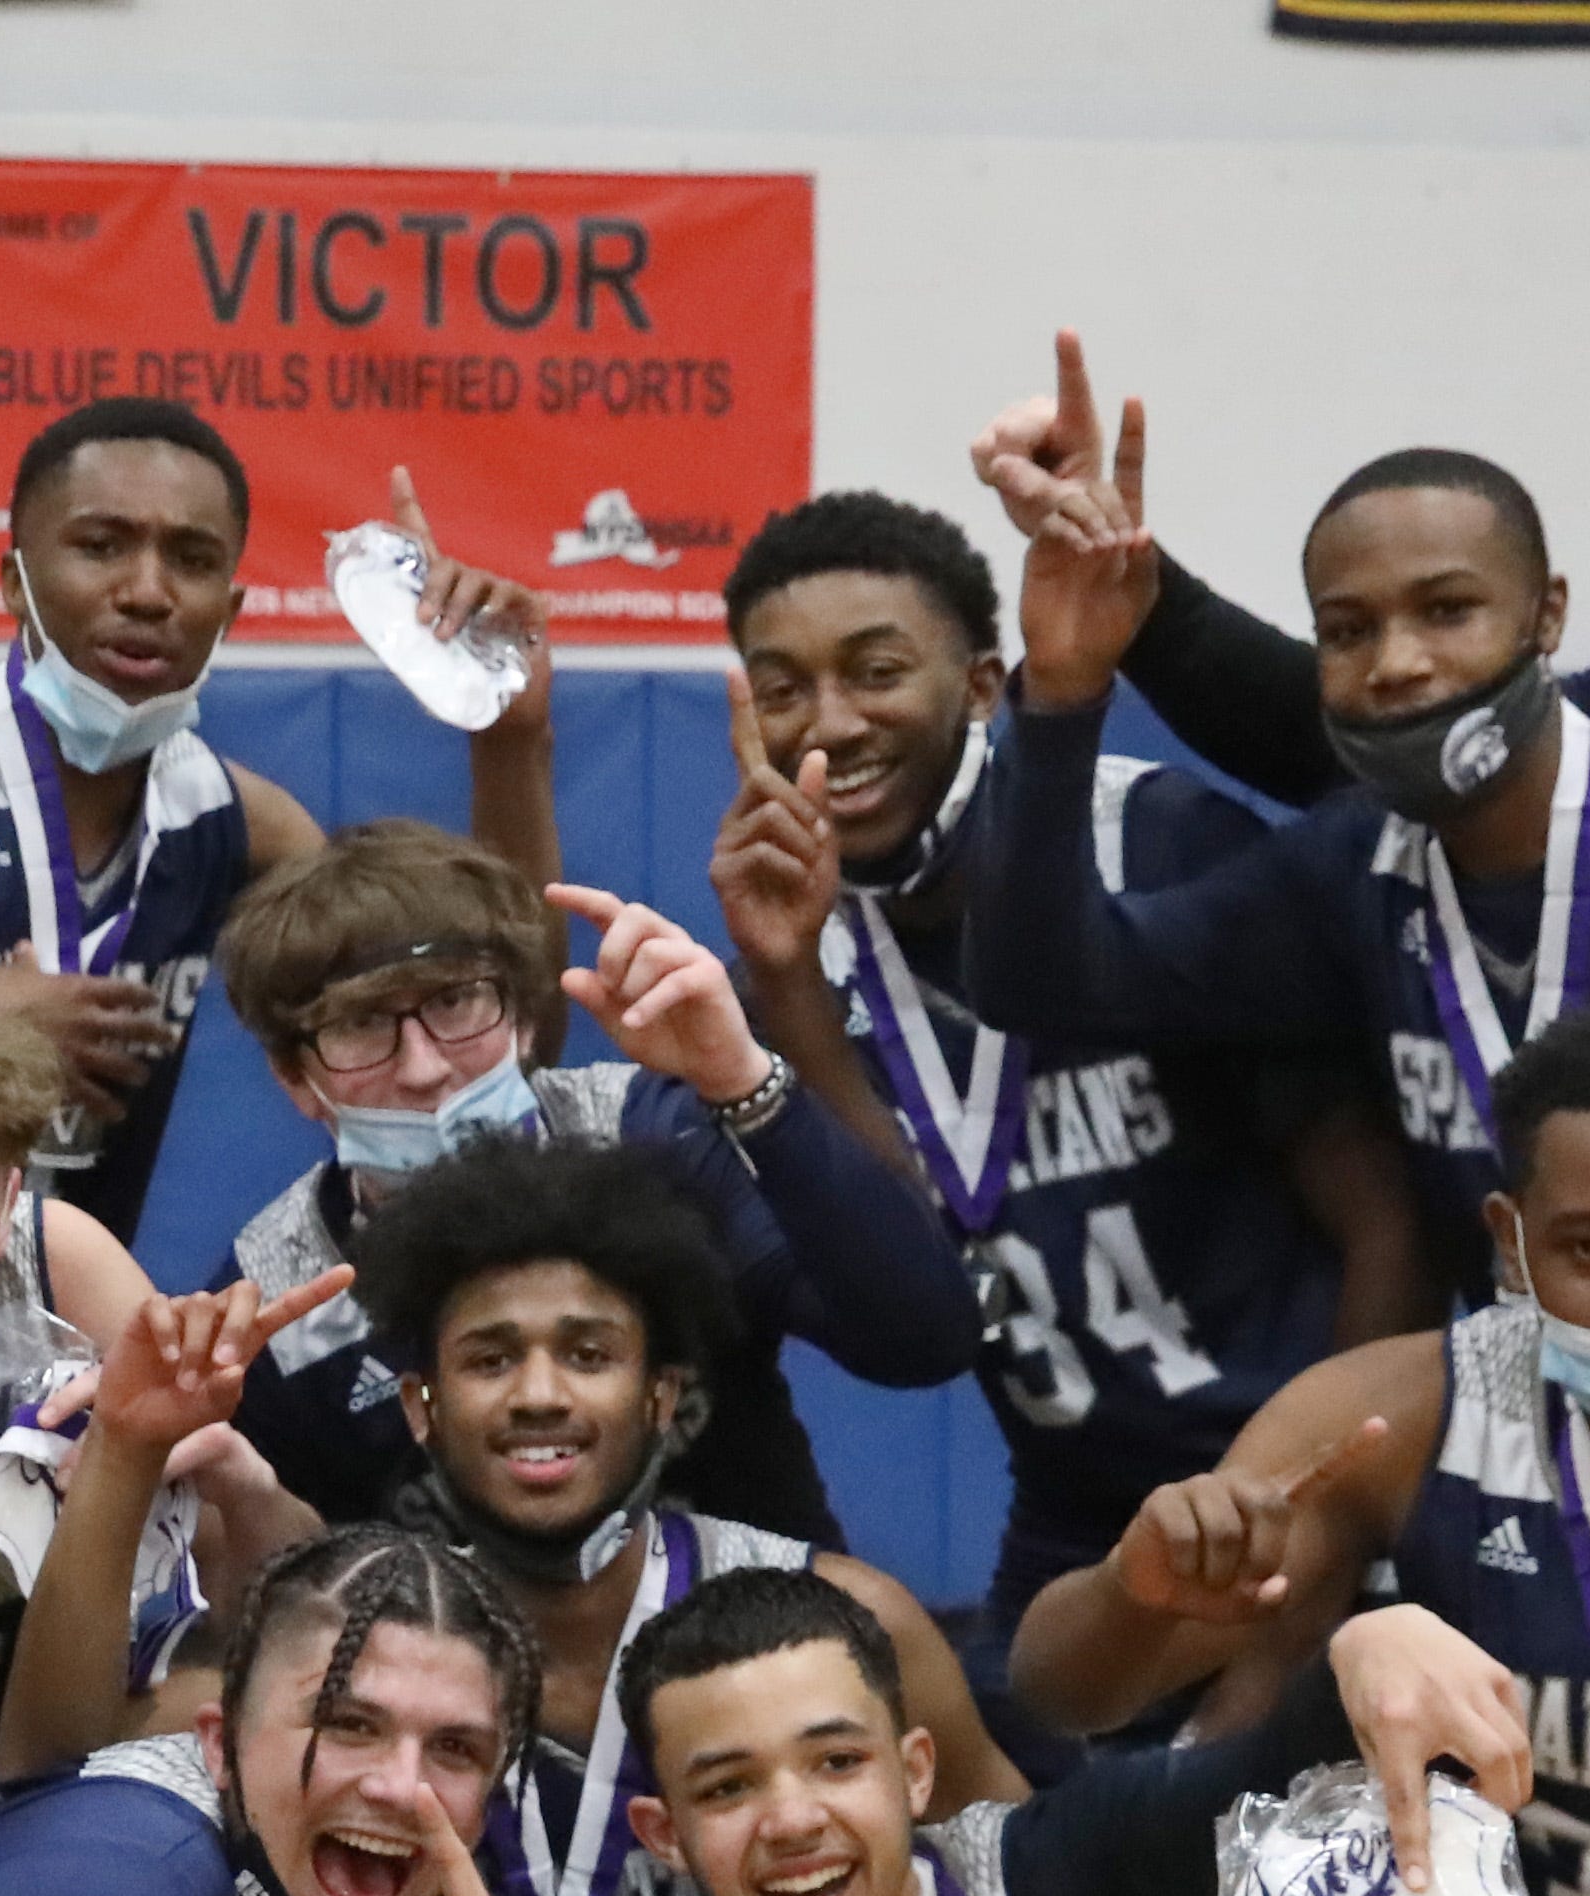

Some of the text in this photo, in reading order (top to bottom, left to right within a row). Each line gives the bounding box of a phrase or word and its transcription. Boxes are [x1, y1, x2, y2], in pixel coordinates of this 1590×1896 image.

[187, 206, 652, 332] VICTOR
[135, 350, 311, 411] DEVILS
[327, 354, 521, 413] UNIFIED
[536, 357, 733, 418] SPORTS
[994, 1202, 1224, 1428] 34
